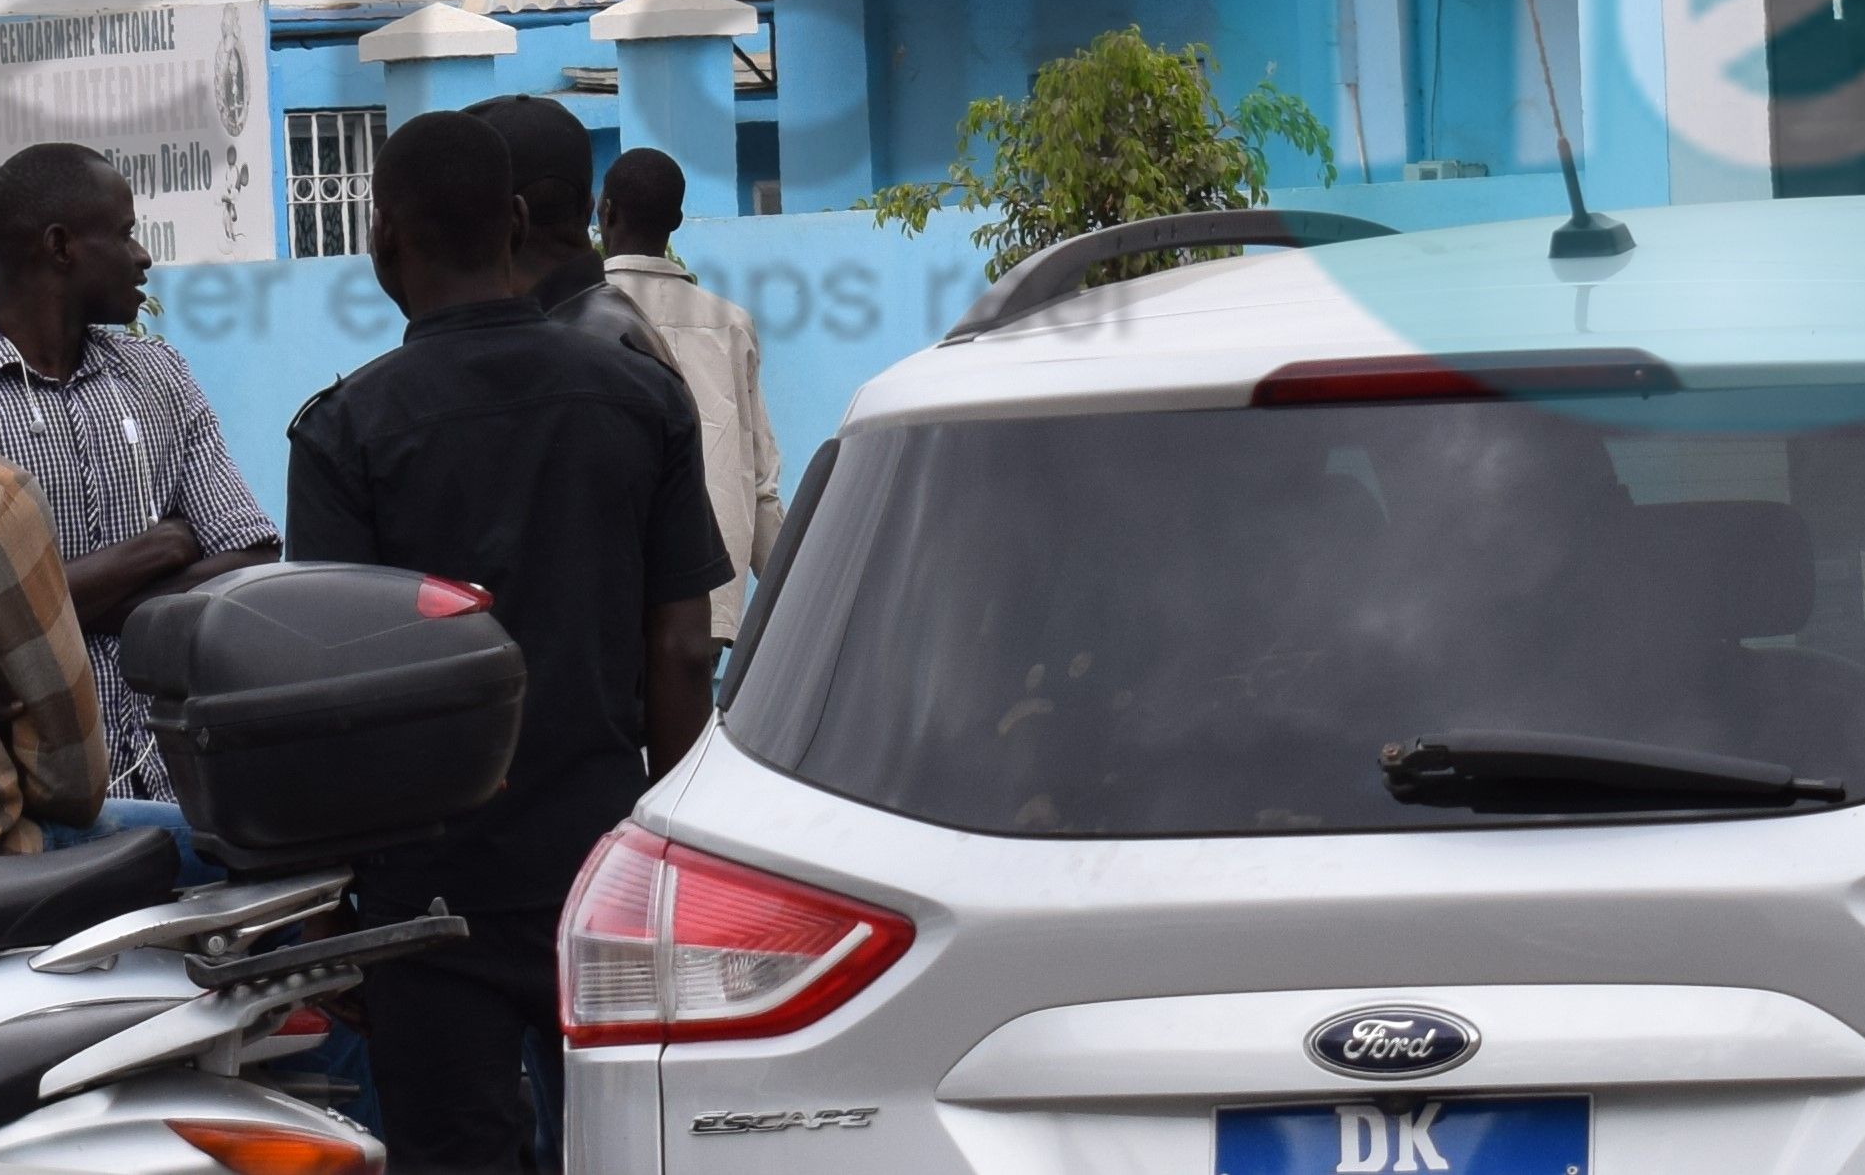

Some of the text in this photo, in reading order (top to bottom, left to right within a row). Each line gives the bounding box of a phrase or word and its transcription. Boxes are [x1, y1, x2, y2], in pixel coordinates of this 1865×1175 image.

[0, 7, 176, 65] GENDARMERIE NATIONALE
[52, 59, 210, 139] MATERNELLE
[103, 141, 213, 200] ierry Diallo
[1342, 1018, 1437, 1060] Ford
[688, 1107, 880, 1136] ESCAPE
[1337, 1104, 1450, 1172] DK
